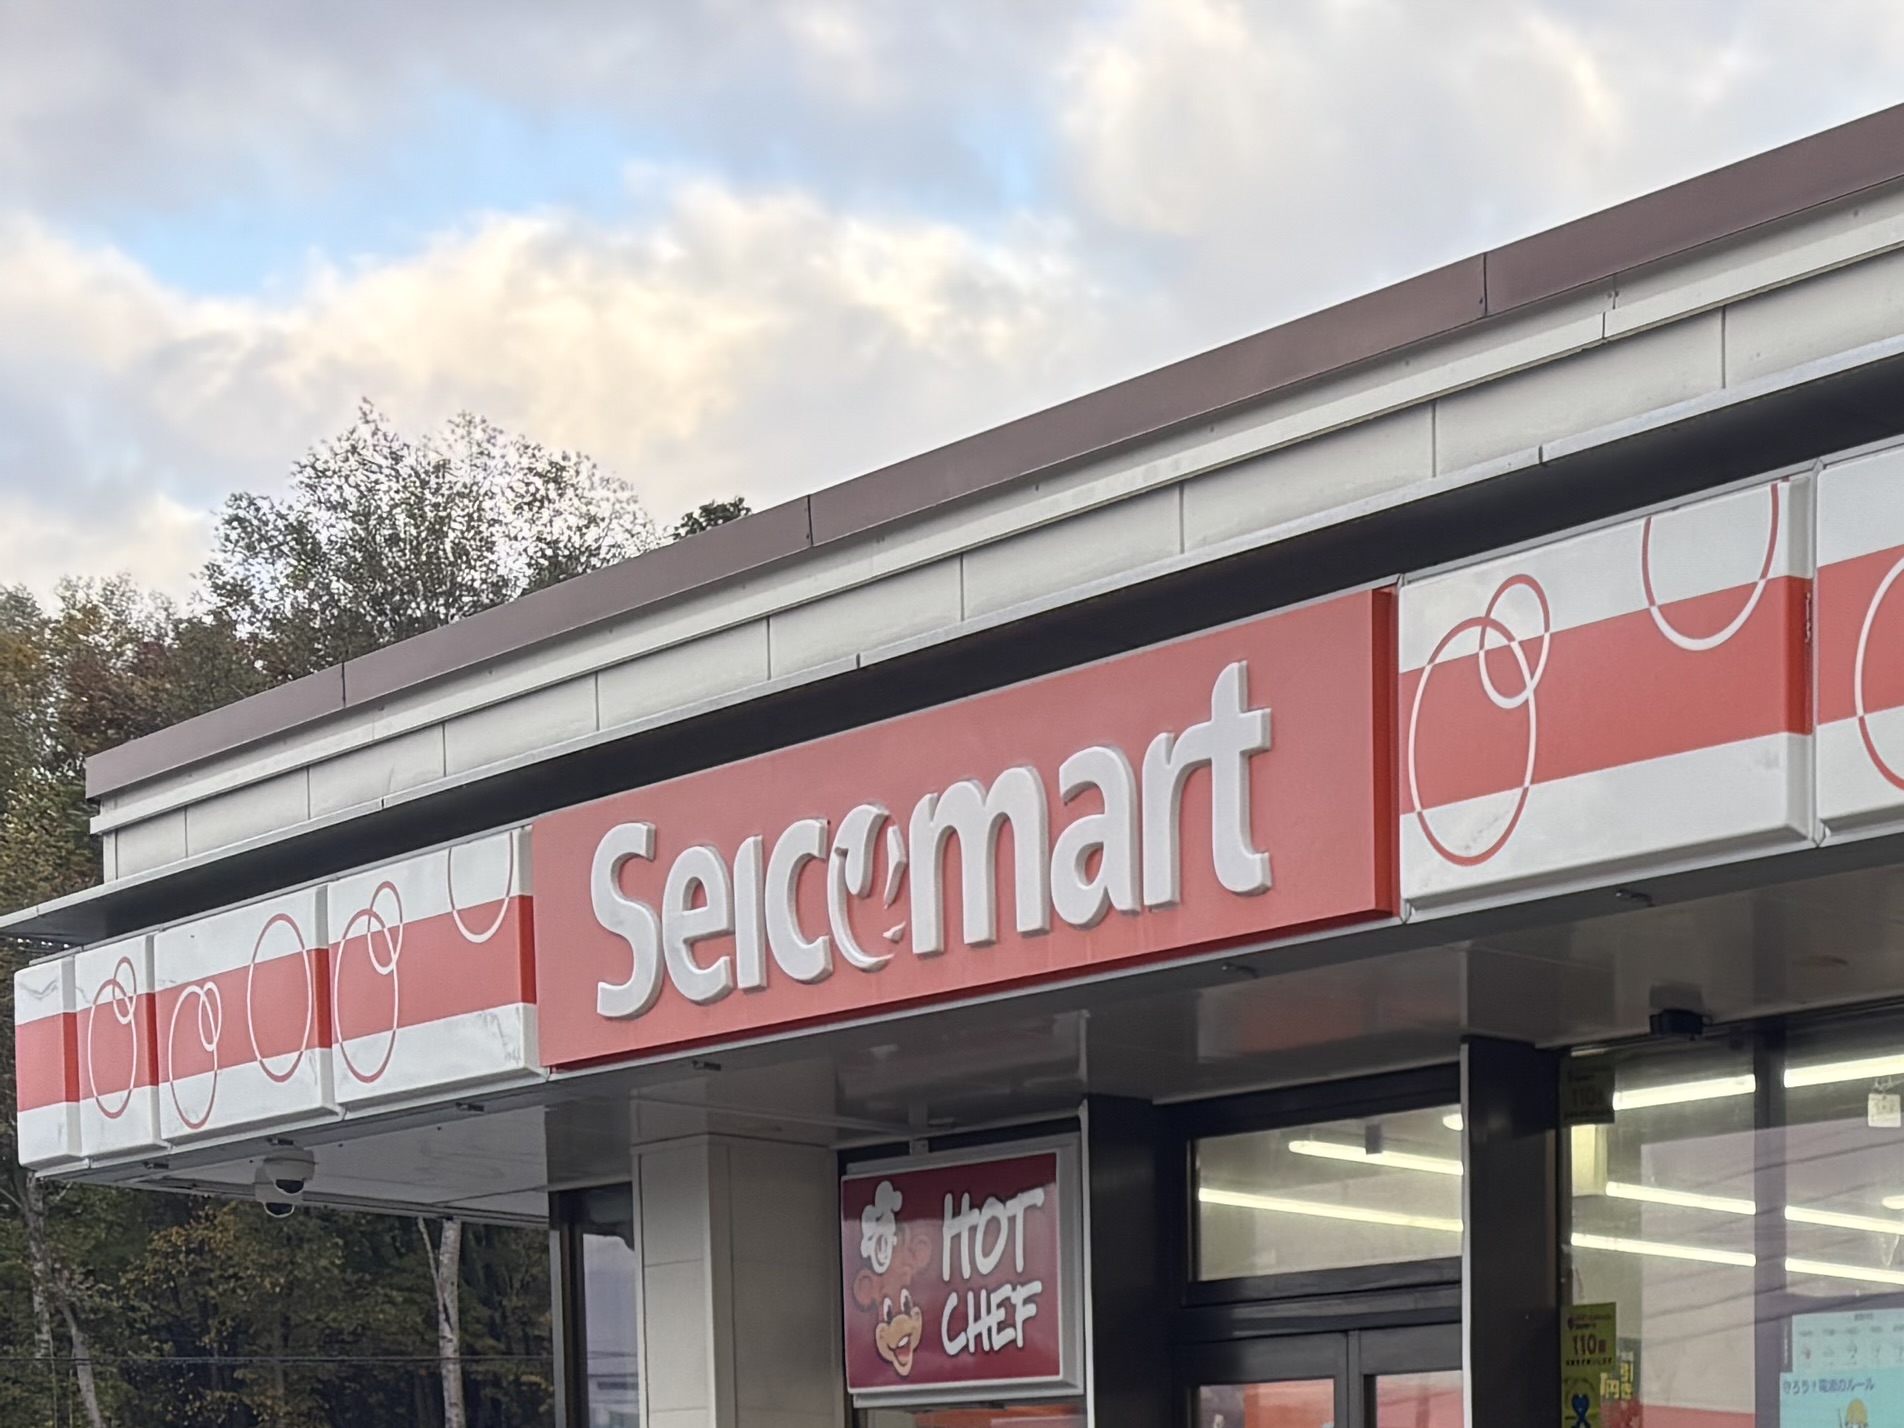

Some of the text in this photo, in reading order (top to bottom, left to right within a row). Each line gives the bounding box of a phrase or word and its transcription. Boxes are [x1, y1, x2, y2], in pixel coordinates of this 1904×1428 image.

[589, 661, 1272, 1019] Seicomart
[942, 1186, 1044, 1281] HOT
[942, 1280, 1042, 1358] CHEF
